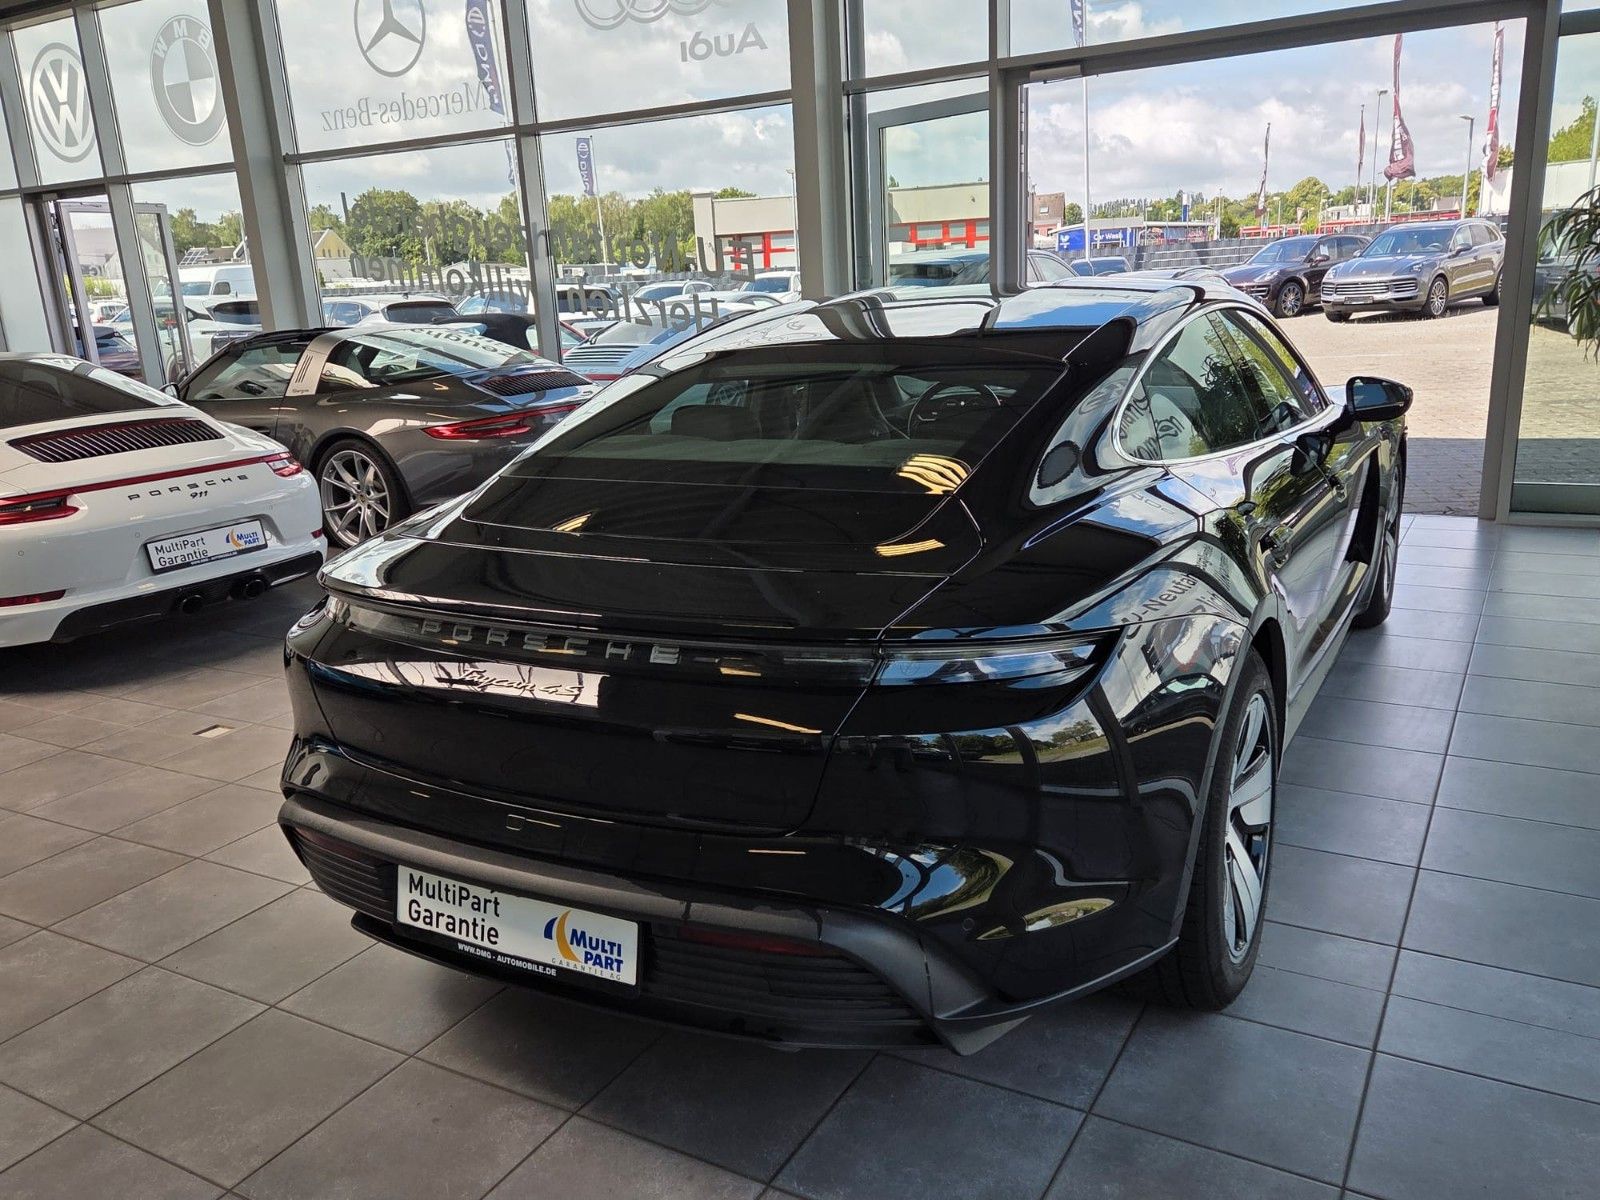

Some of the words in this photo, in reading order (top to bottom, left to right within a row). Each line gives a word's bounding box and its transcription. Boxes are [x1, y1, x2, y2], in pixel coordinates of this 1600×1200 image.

[128, 474, 249, 501] PORSCHE
[189, 490, 209, 499] 911
[154, 536, 206, 556] MultiPart
[158, 548, 209, 567] Garantie
[421, 617, 682, 665] PORSCHE
[408, 873, 500, 918] MultiPart
[408, 899, 499, 945] Garantie
[569, 928, 622, 958] MULTI
[583, 950, 624, 974] PART
